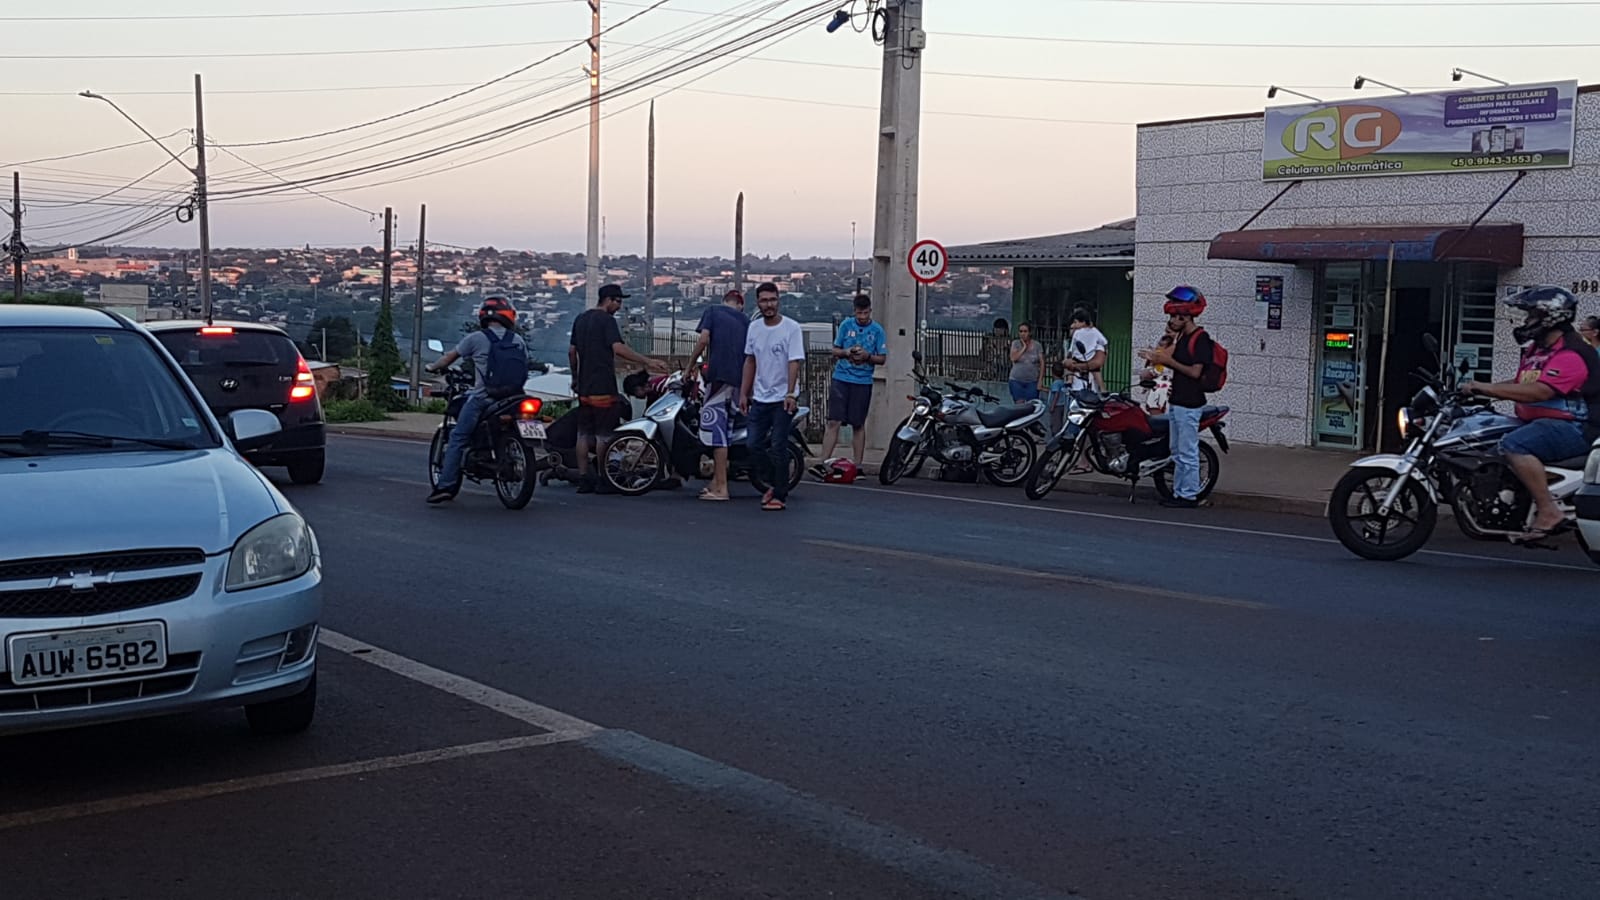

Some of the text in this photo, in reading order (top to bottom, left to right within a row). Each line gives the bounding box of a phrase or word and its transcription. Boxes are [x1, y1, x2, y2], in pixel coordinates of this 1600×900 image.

[1458, 94, 1494, 103] CONSERTO
[1507, 90, 1548, 99] CELULARES
[1496, 100, 1511, 108] PARA
[1488, 114, 1524, 122] CONSERTOS
[1530, 112, 1555, 120] VENDAS
[1294, 112, 1382, 153] RG
[1278, 166, 1324, 175] Celulares
[1336, 161, 1402, 173] Informática
[1452, 158, 1464, 167] 45
[916, 249, 939, 267] 40
